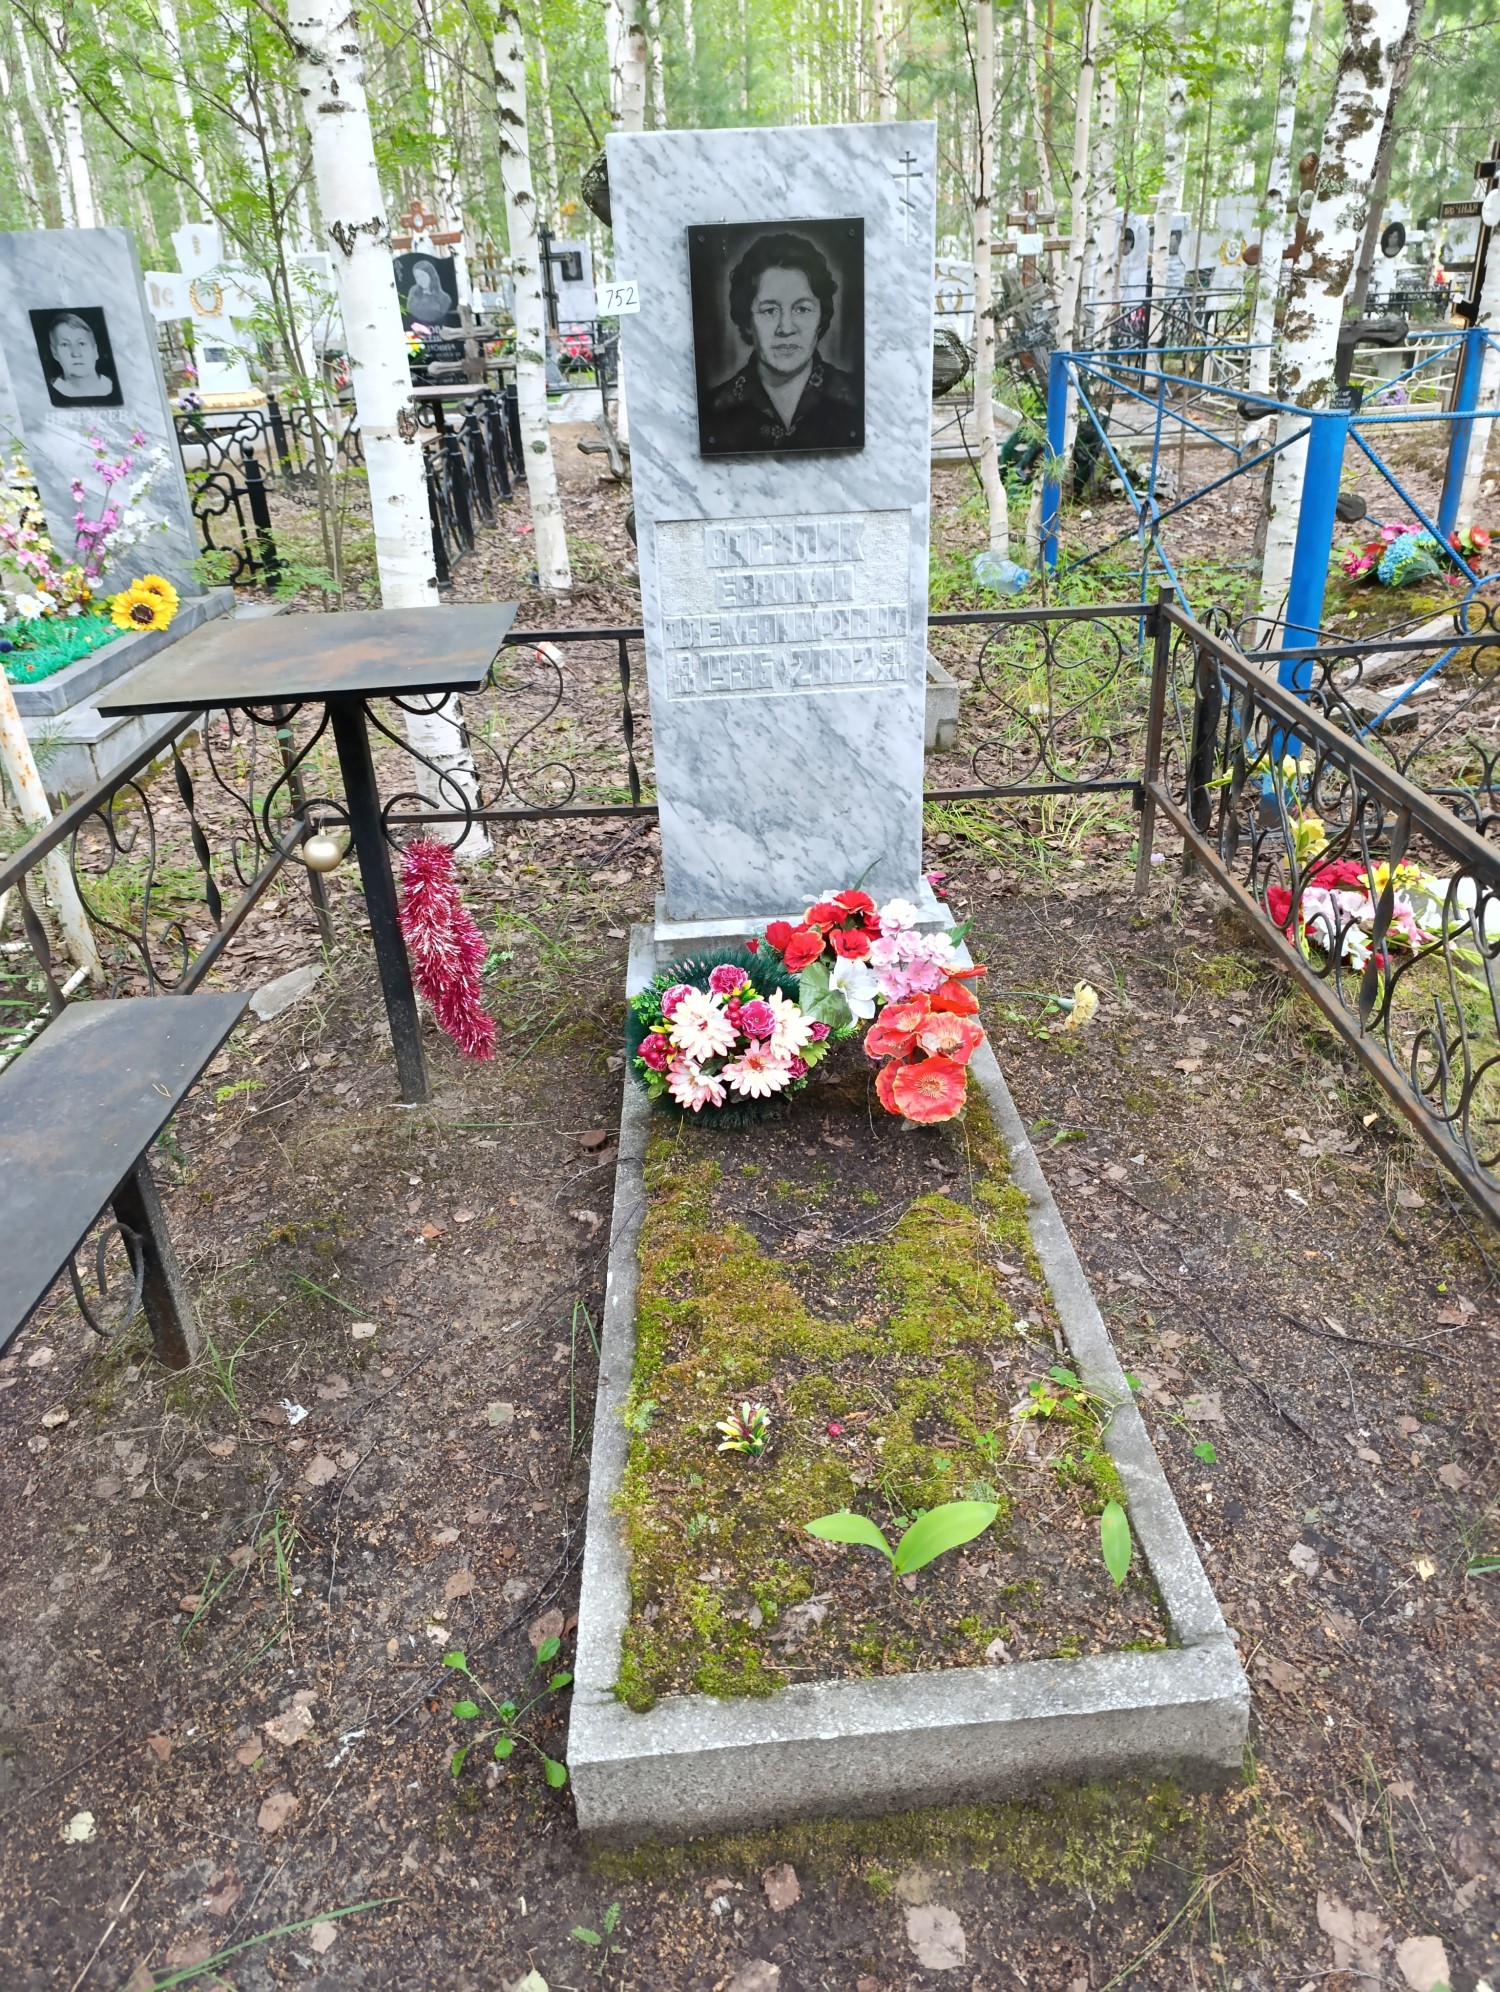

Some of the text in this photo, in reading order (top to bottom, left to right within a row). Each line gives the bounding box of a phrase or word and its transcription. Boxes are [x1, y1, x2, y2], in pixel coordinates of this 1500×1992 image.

[606, 286, 637, 309] 752
[717, 568, 855, 608] ЕВДОКИЯ
[663, 605, 908, 648] АЛЕКСАНДРОВНА
[791, 645, 874, 687] 2002
